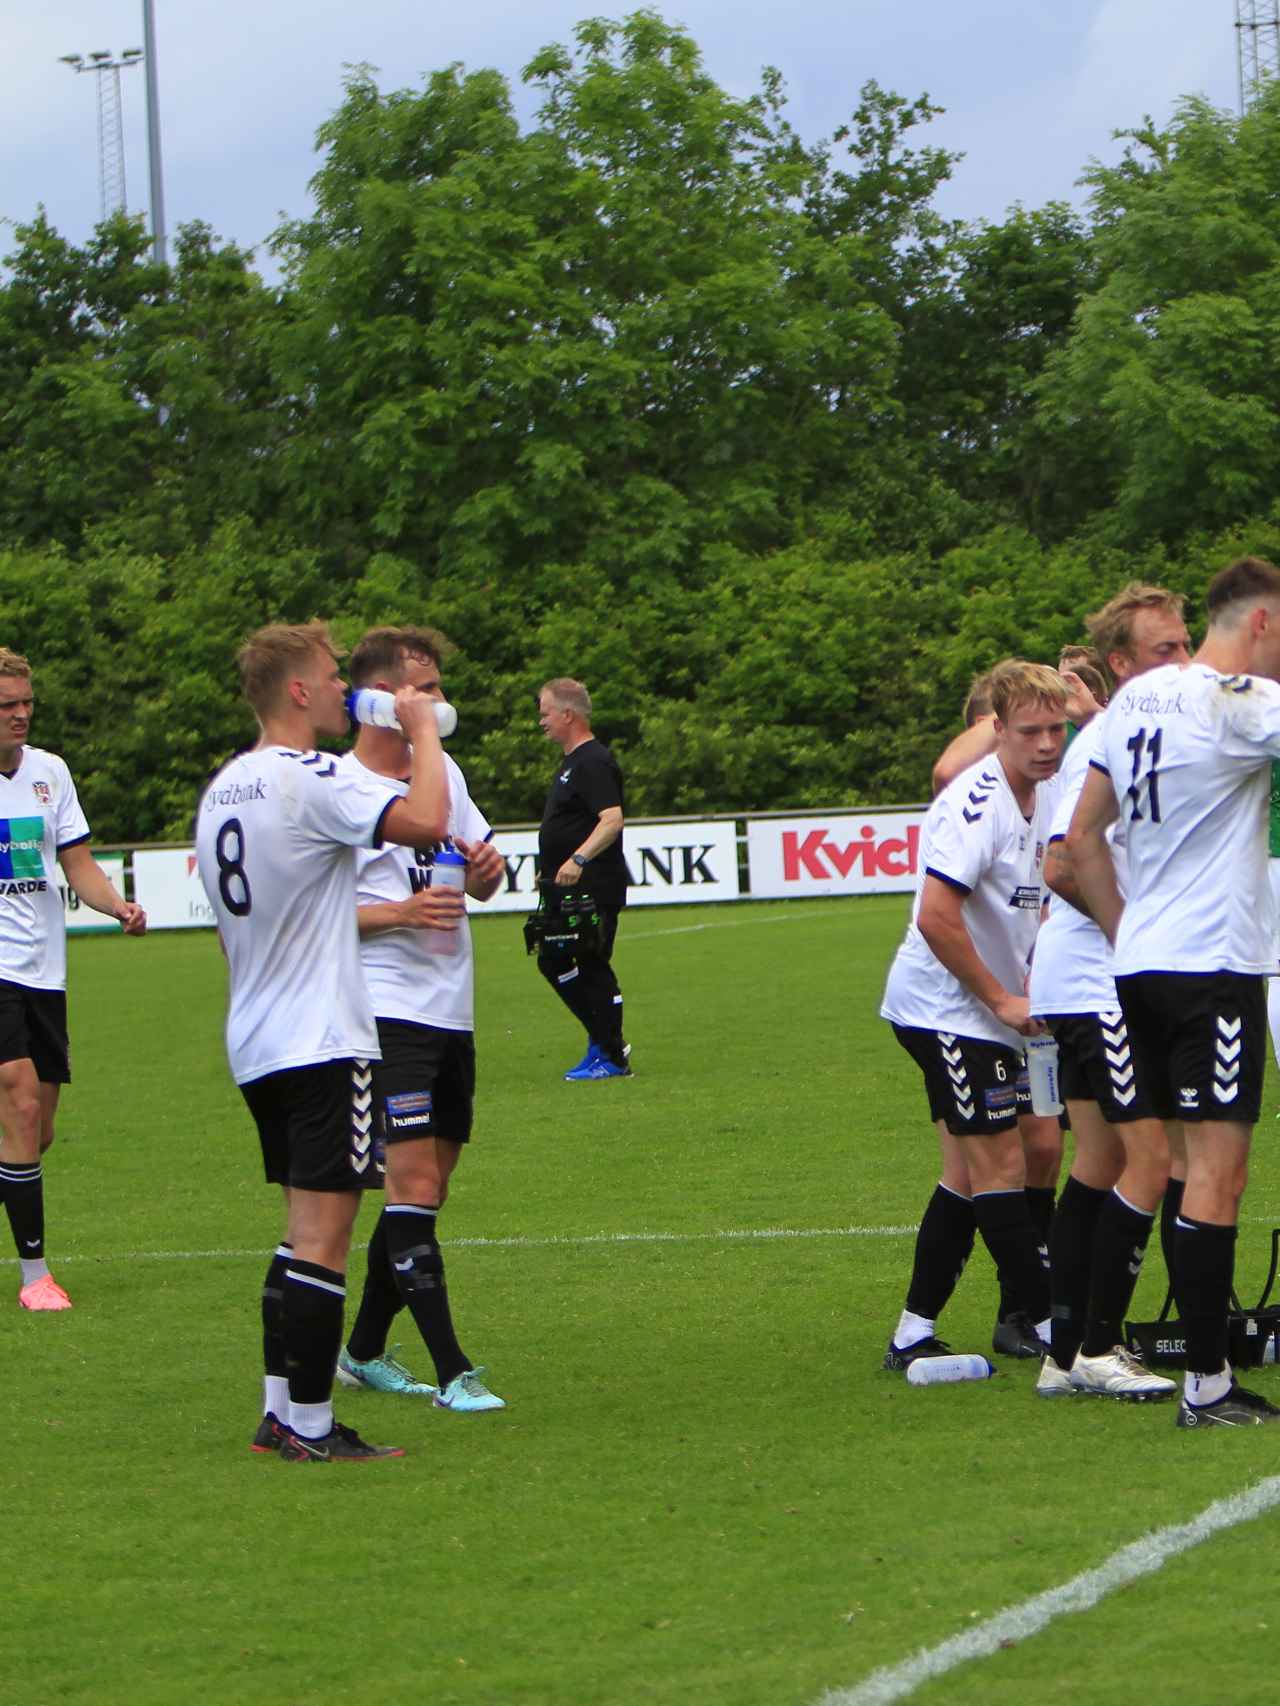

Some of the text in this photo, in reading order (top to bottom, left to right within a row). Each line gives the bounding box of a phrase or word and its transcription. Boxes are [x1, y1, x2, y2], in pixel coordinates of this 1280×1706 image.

[1127, 727, 1162, 824] 11
[216, 817, 251, 917] 8
[995, 1060, 1006, 1081] 6
[392, 1112, 430, 1128] hummel
